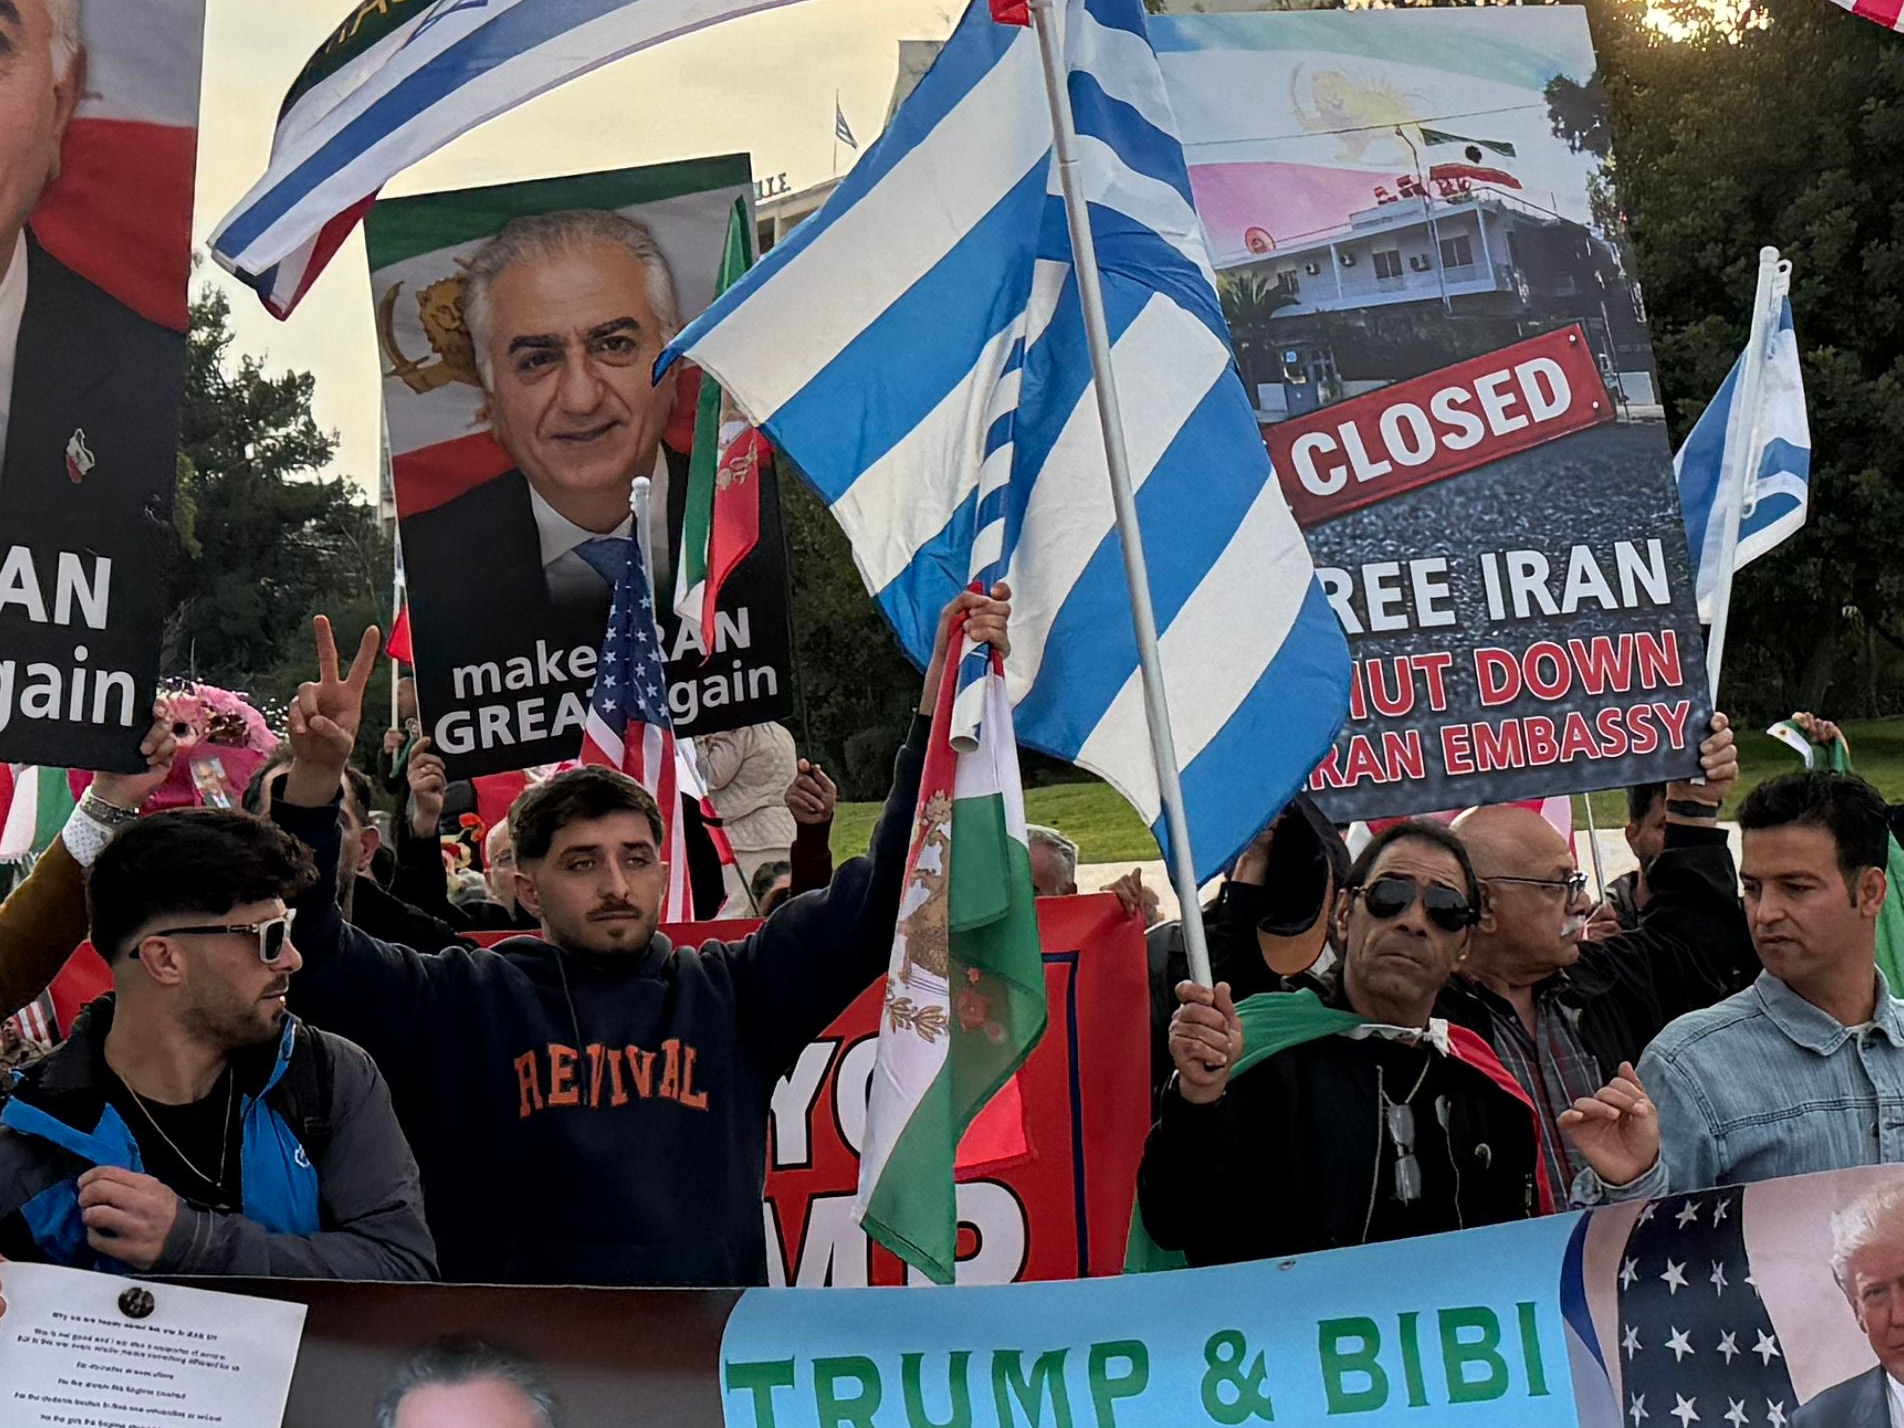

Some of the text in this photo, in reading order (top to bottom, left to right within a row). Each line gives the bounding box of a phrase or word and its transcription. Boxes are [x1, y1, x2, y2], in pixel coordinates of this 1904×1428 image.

[1291, 355, 1574, 498] CLOSED
[1315, 538, 1671, 634] REE IRAN
[453, 607, 751, 699] make RAN
[1350, 629, 1683, 721] UT DOWN
[434, 660, 778, 755] GREA gain
[1302, 700, 1690, 792] RAN EMBASSY
[513, 1038, 709, 1119] REVIVAL
[1200, 1329, 1276, 1424] &
[1317, 1300, 1551, 1416] BIBI
